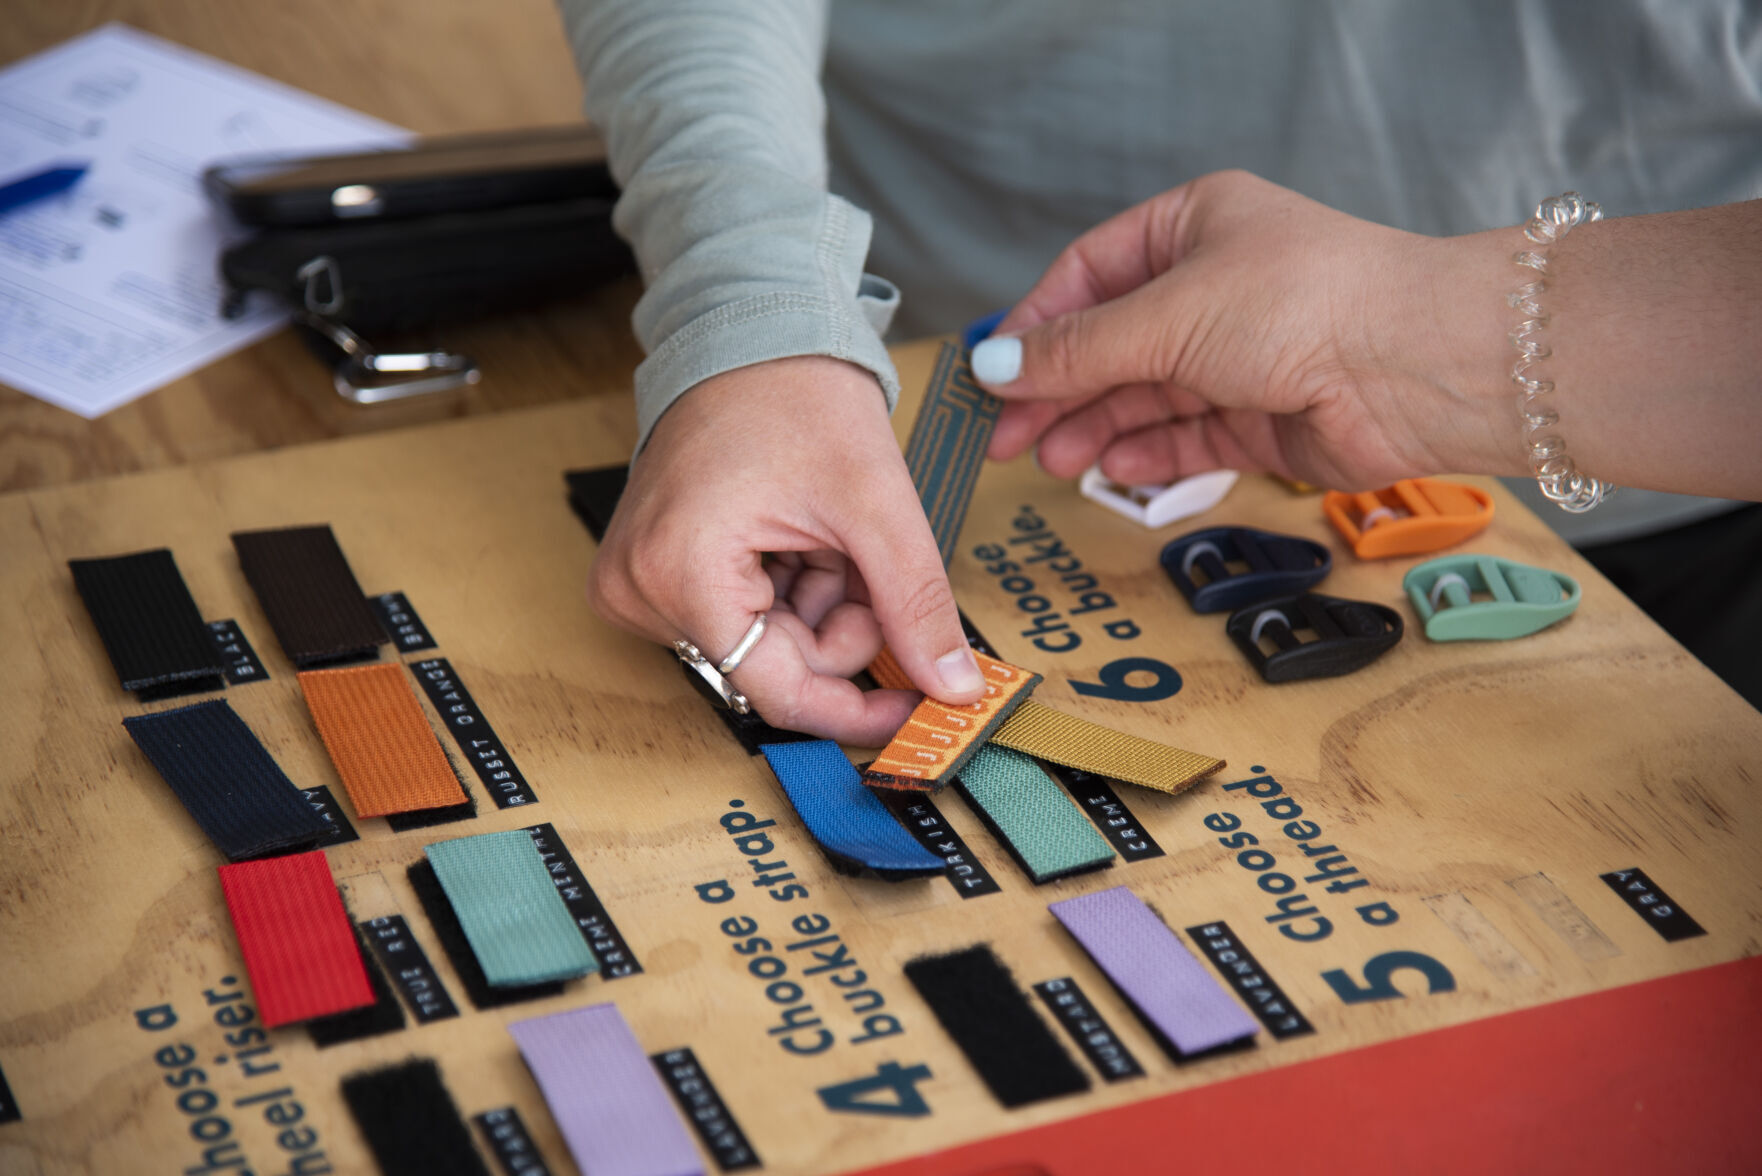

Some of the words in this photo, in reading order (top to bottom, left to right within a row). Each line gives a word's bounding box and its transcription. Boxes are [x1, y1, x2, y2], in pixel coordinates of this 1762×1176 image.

[1008, 505, 1118, 615] buckle.
[973, 543, 1082, 653] Choose
[1103, 619, 1141, 640] a
[421, 660, 474, 725] ORANGE
[1067, 657, 1183, 702] 6
[472, 739, 528, 805] RUSSET
[720, 799, 809, 902] strap.
[908, 804, 983, 888] TURKISH
[1088, 794, 1149, 851] CREME
[1222, 765, 1370, 894] thread.
[694, 879, 735, 904] a
[1204, 812, 1334, 942] Choose
[1615, 870, 1674, 917] GRAY
[372, 917, 406, 952] RED
[579, 916, 633, 977] CREME
[1355, 902, 1400, 927] a
[401, 967, 440, 1015] TRUE
[720, 915, 835, 1057] Choose
[785, 913, 905, 1045] buckle
[1203, 924, 1299, 1030] LAVENDER
[1320, 951, 1457, 1005] 5
[134, 1003, 178, 1031] a
[203, 975, 281, 1078] riser.
[1046, 979, 1132, 1074] MUSTARD
[154, 1043, 256, 1176] hoose
[816, 1061, 935, 1118] 4
